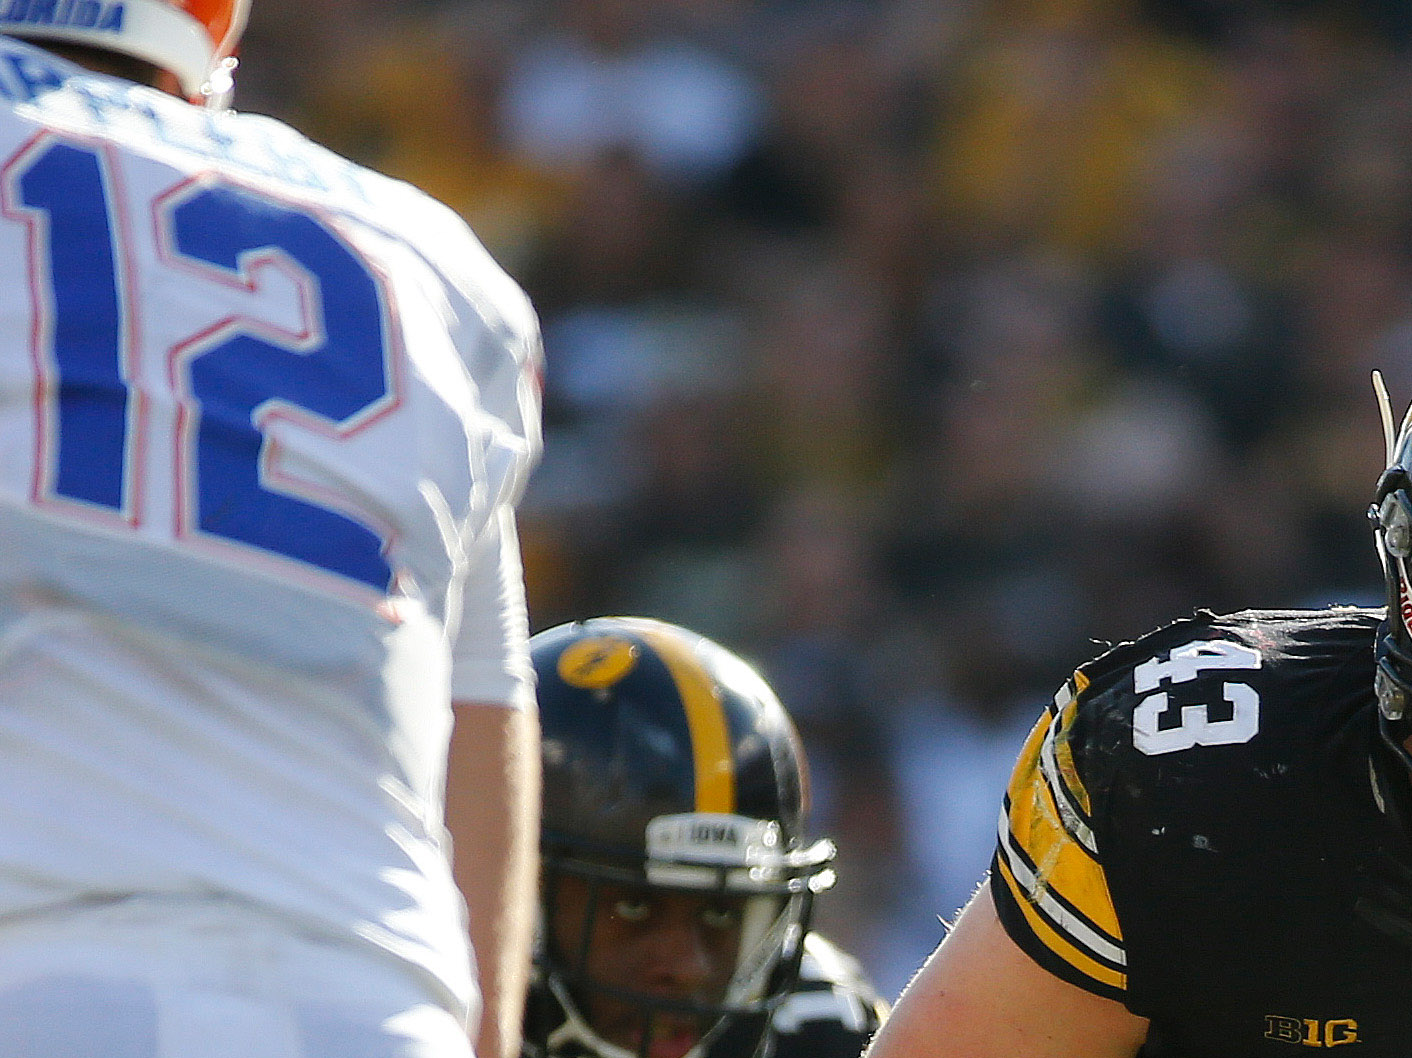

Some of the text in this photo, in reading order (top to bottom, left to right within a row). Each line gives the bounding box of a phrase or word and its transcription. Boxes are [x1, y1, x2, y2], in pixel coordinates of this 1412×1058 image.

[3, 130, 402, 615] 12
[1133, 640, 1262, 756] 43
[690, 824, 738, 845] IOWA
